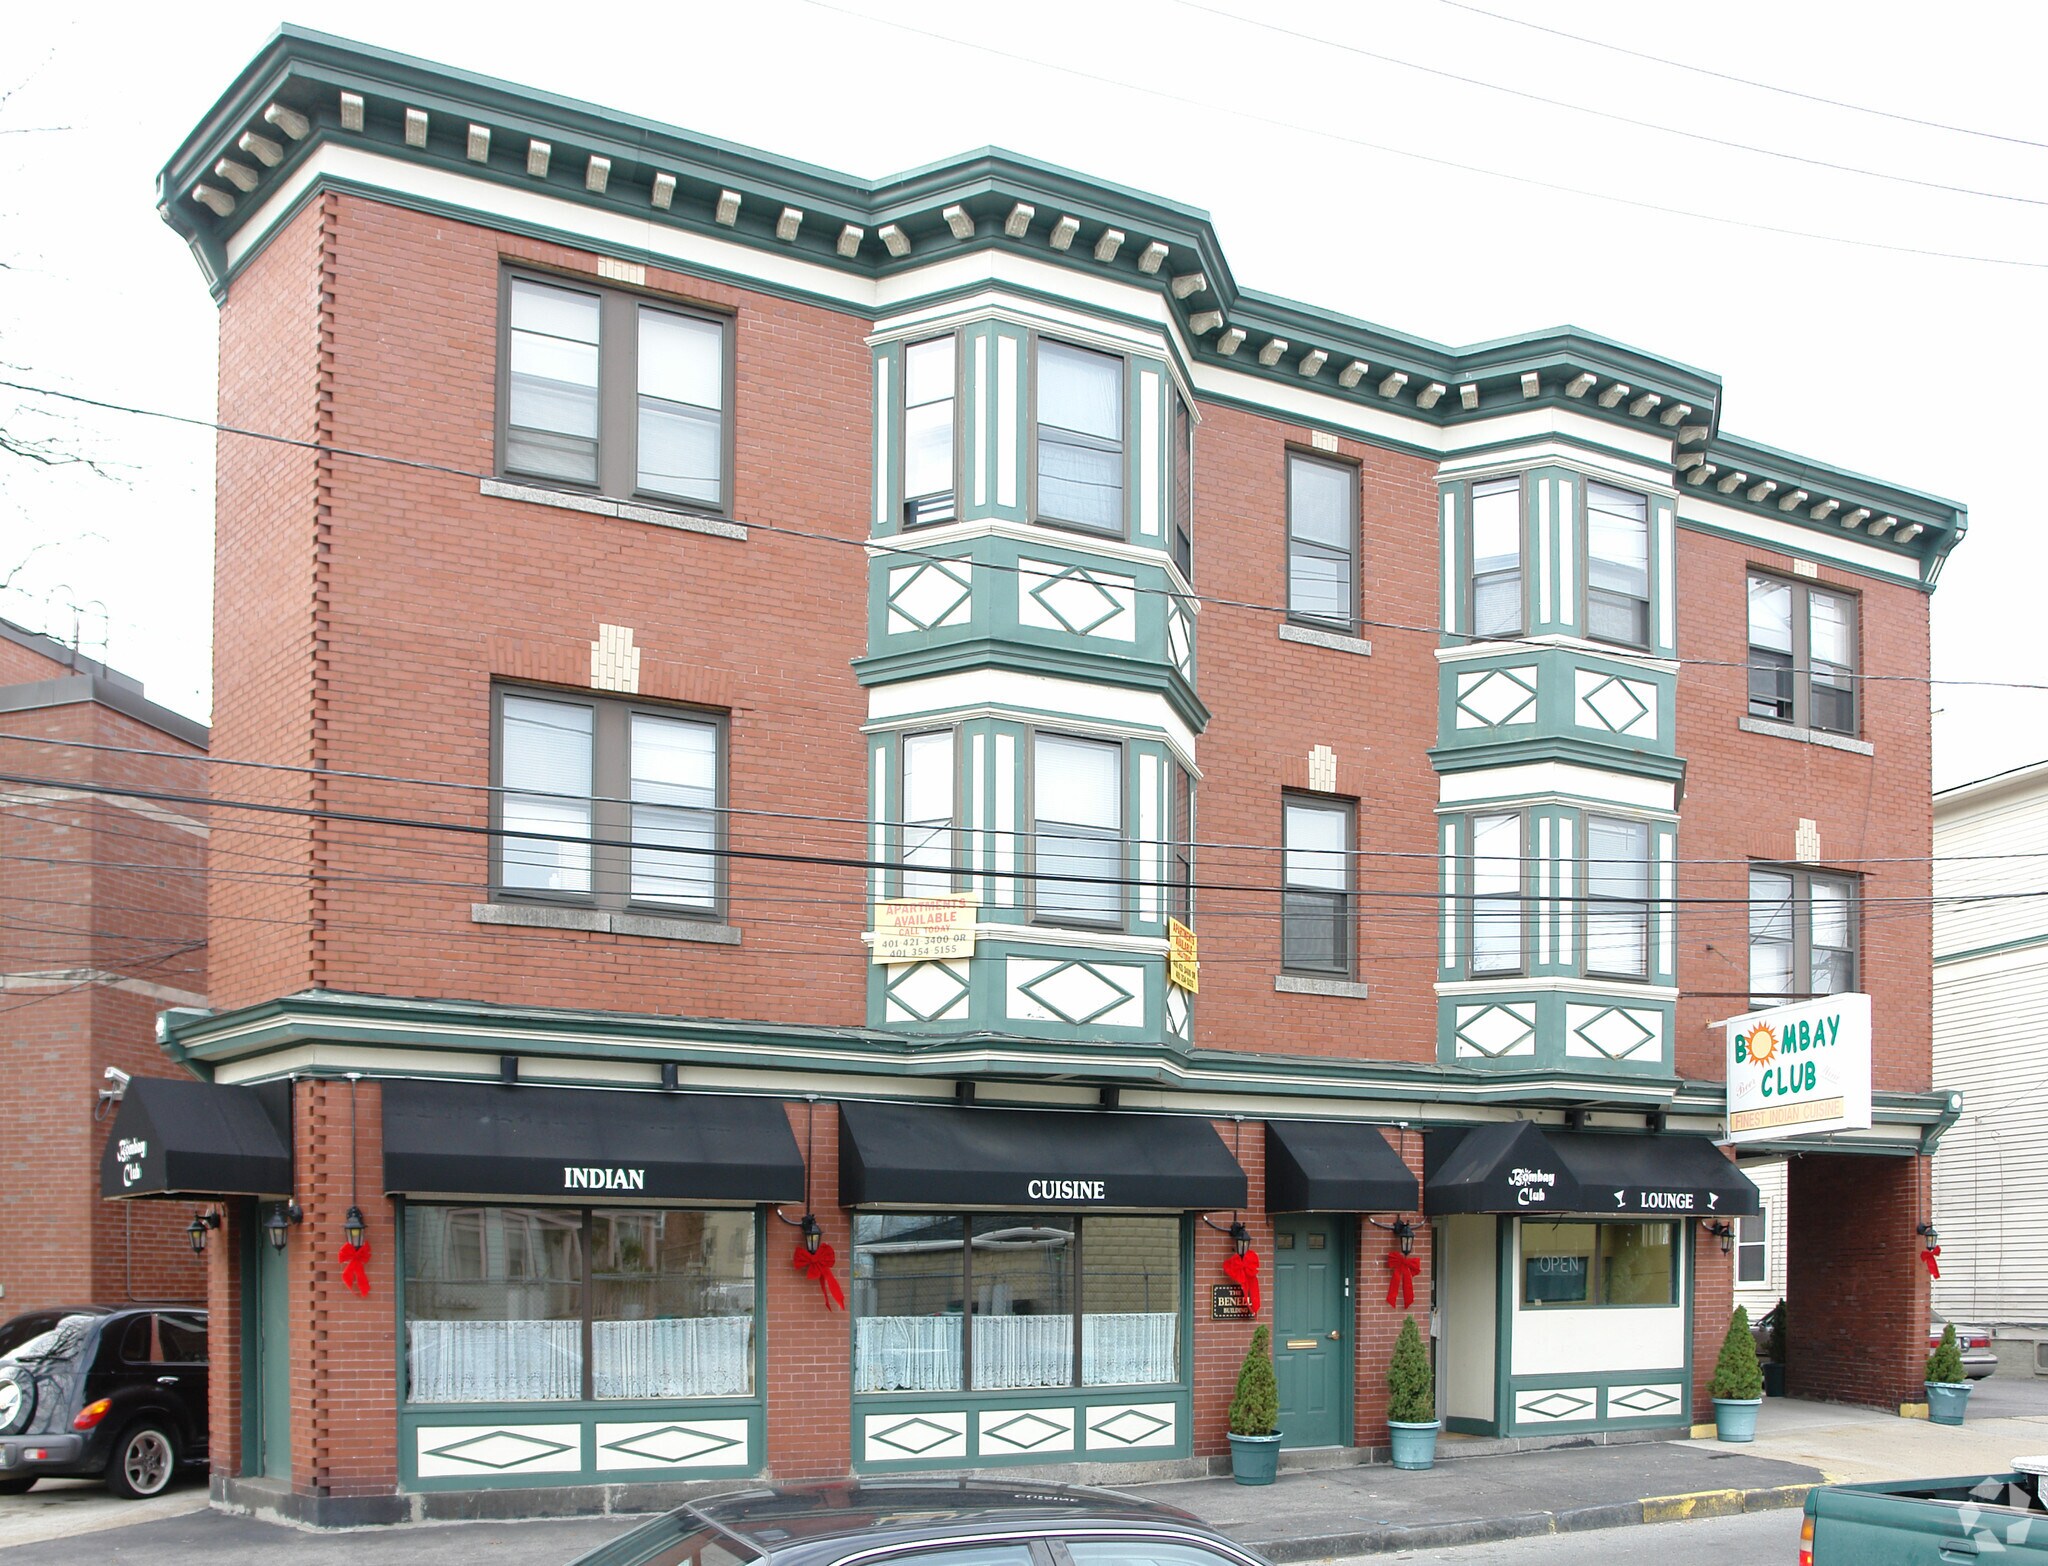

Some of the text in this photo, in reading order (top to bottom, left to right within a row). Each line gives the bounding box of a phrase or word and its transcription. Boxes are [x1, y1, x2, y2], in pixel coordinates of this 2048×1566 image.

[886, 898, 966, 915] APARTMENTS
[895, 911, 957, 927] AVAILABLE
[899, 924, 951, 936] CALL TODAY
[882, 934, 966, 948] 401 421 3400 OR
[912, 947, 929, 956] 354
[934, 945, 957, 954] 5155
[1761, 1061, 1816, 1097] CLUB
[1735, 1100, 1840, 1129] FINEST INDIAN CUISINE
[123, 1163, 142, 1187] Club
[564, 1167, 645, 1190] INDIAN
[1508, 1168, 1555, 1187] Bombay
[1028, 1180, 1105, 1200] CUISINE
[1517, 1187, 1545, 1206] Club
[1641, 1192, 1693, 1209] LOUNGE
[1539, 1255, 1579, 1273] OPEN
